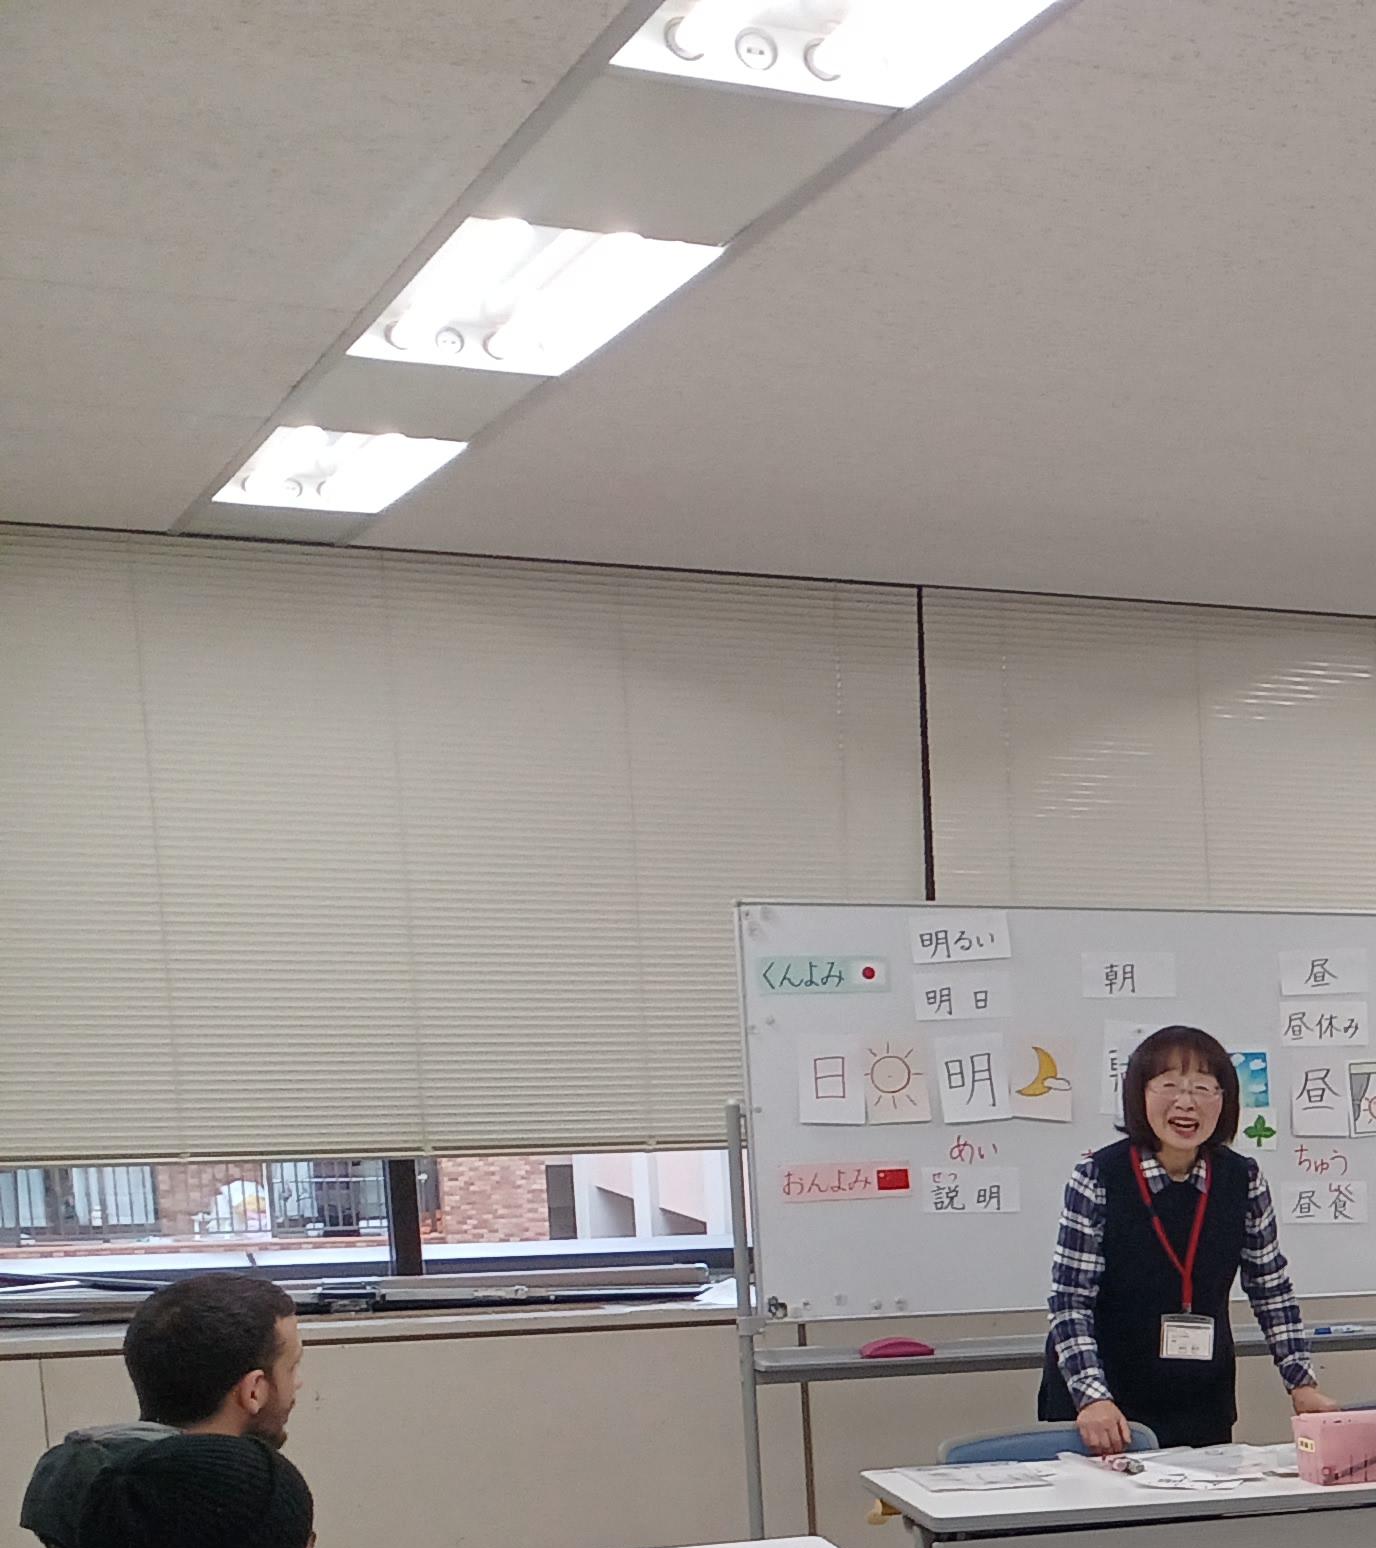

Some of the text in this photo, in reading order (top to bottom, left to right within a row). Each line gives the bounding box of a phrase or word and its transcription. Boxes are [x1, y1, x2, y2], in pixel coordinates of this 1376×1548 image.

[920, 929, 995, 958] 明るい
[762, 961, 845, 989] くんよみ
[1104, 963, 1136, 994] 朝
[1304, 958, 1338, 988] 昼
[925, 987, 989, 1016] 明日
[1283, 1011, 1359, 1040] 昼休み
[813, 1055, 846, 1099] 日
[945, 1052, 996, 1107] 明
[1296, 1068, 1342, 1111] 昼
[949, 1135, 999, 1164] めい
[1294, 1144, 1348, 1176] ちゅう
[782, 1168, 871, 1195] おんよみ
[931, 1171, 958, 1184] せつ
[931, 1184, 1001, 1211] 説明
[1291, 1189, 1355, 1220] 昼食
